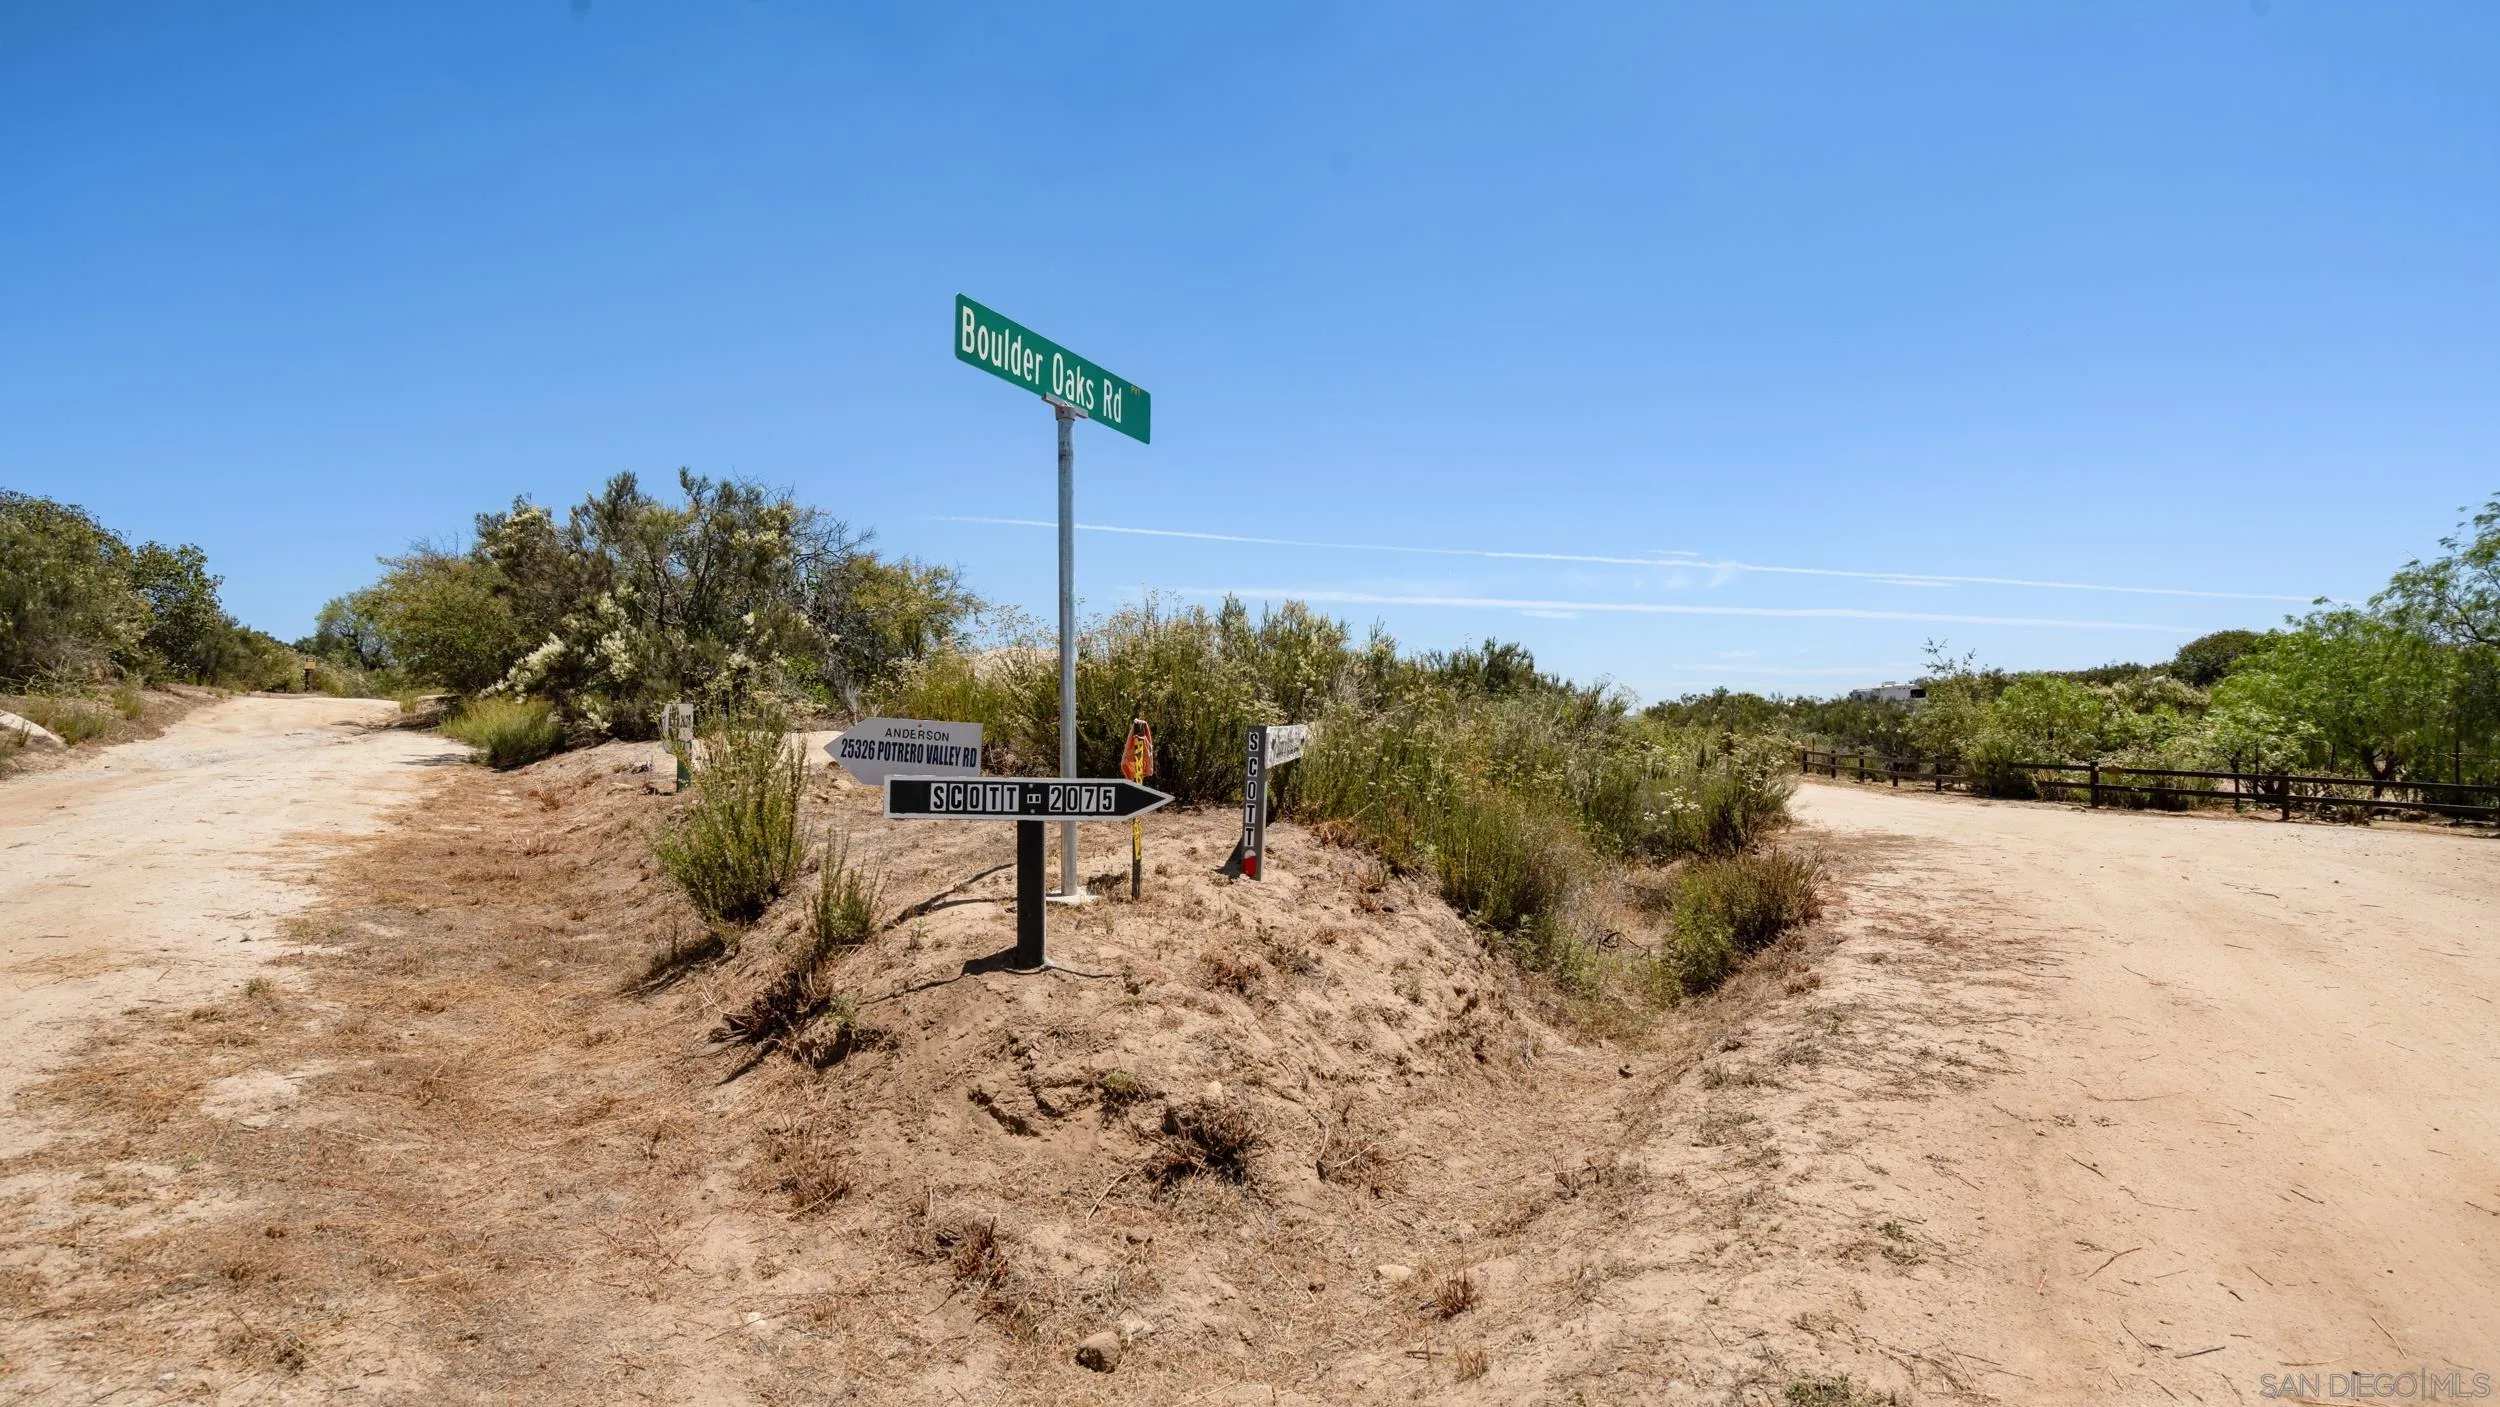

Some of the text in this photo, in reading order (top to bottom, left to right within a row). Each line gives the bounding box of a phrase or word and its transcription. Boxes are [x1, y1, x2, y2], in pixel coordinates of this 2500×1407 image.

[961, 305, 1122, 424] Boulder Oaks Rd
[885, 727, 950, 742] ANDERSON
[840, 738, 978, 768] 25326 POTRERO VALLEY RD
[932, 785, 1017, 810] SCOTT
[1050, 786, 1113, 811] 2075
[1245, 732, 1258, 846] SCOTT
